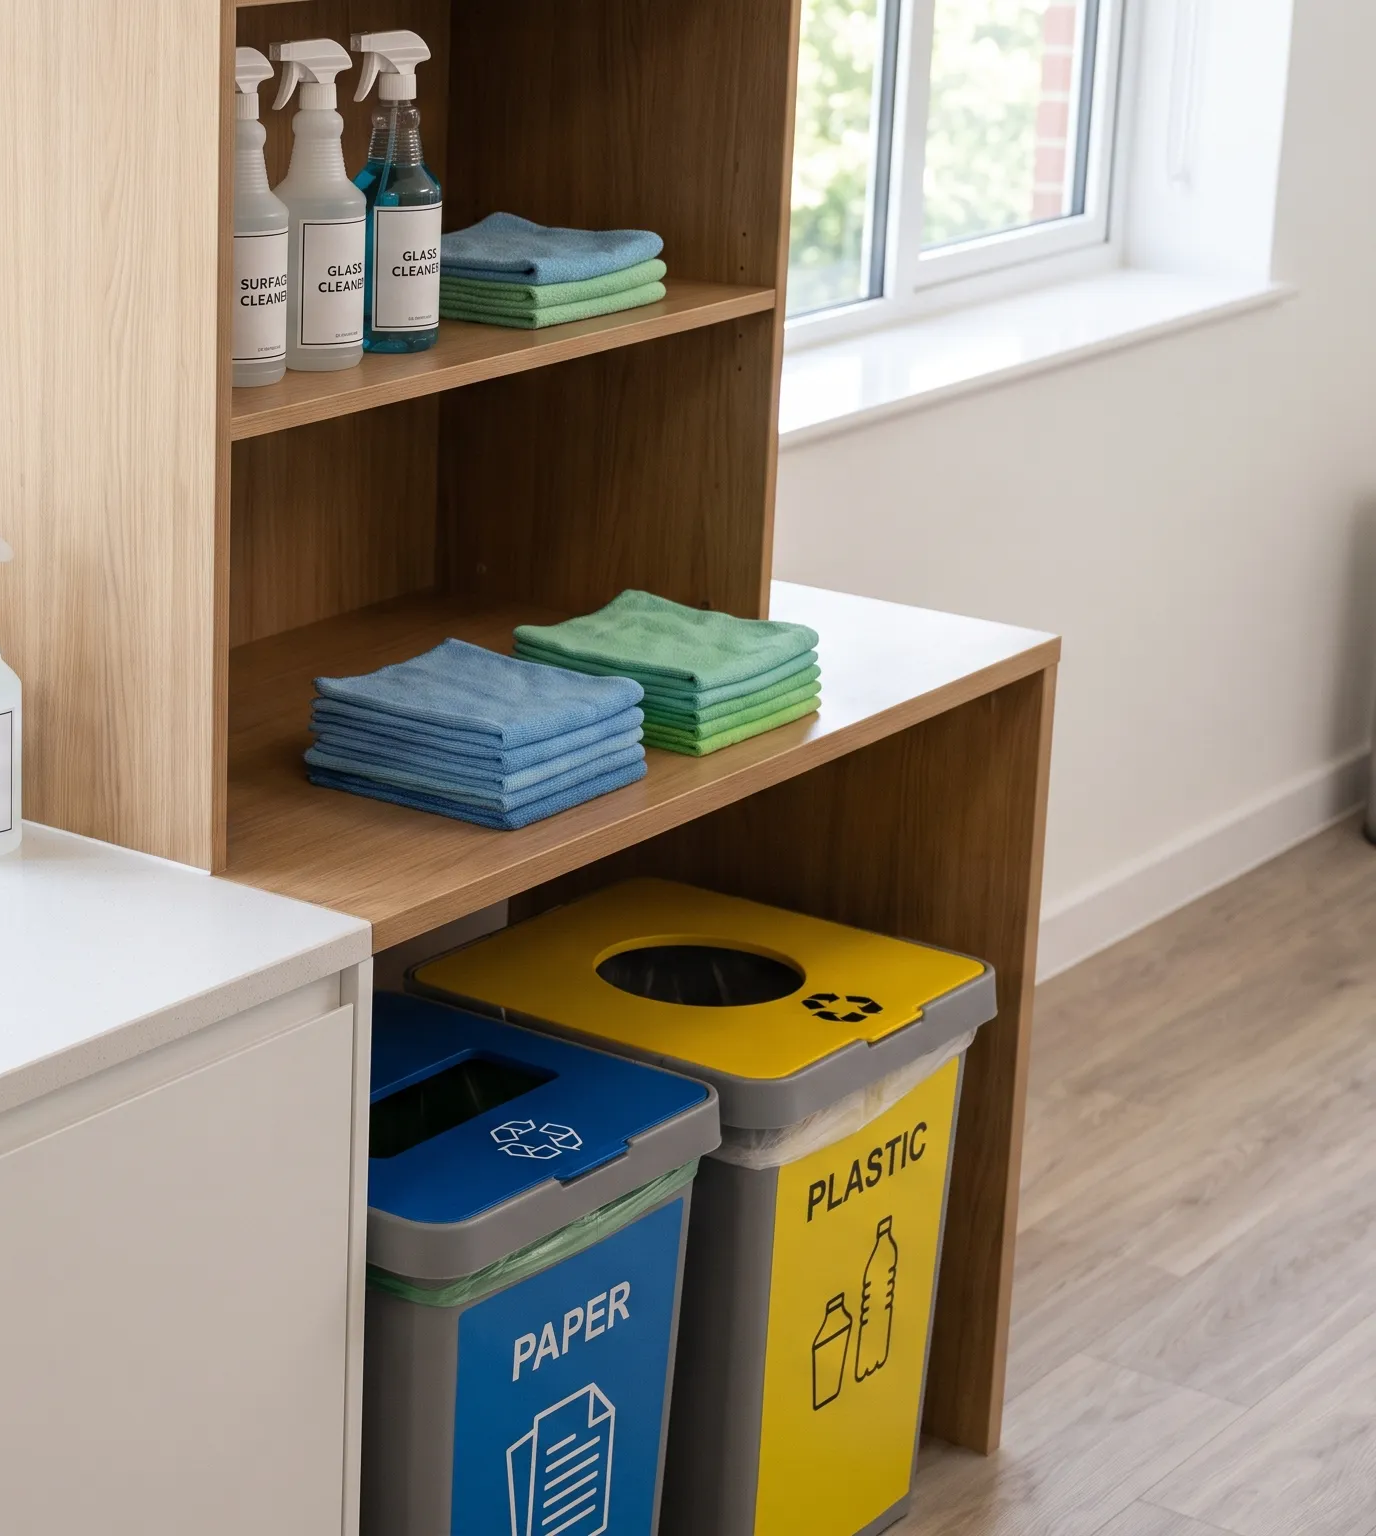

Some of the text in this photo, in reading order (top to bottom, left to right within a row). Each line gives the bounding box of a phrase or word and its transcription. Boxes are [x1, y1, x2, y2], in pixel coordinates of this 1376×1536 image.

[402, 248, 437, 261] GLASS
[327, 262, 362, 276] GLASS
[240, 290, 287, 306] CLEANE
[806, 1121, 928, 1222] PLASTIC
[511, 1280, 632, 1382] PAPER
